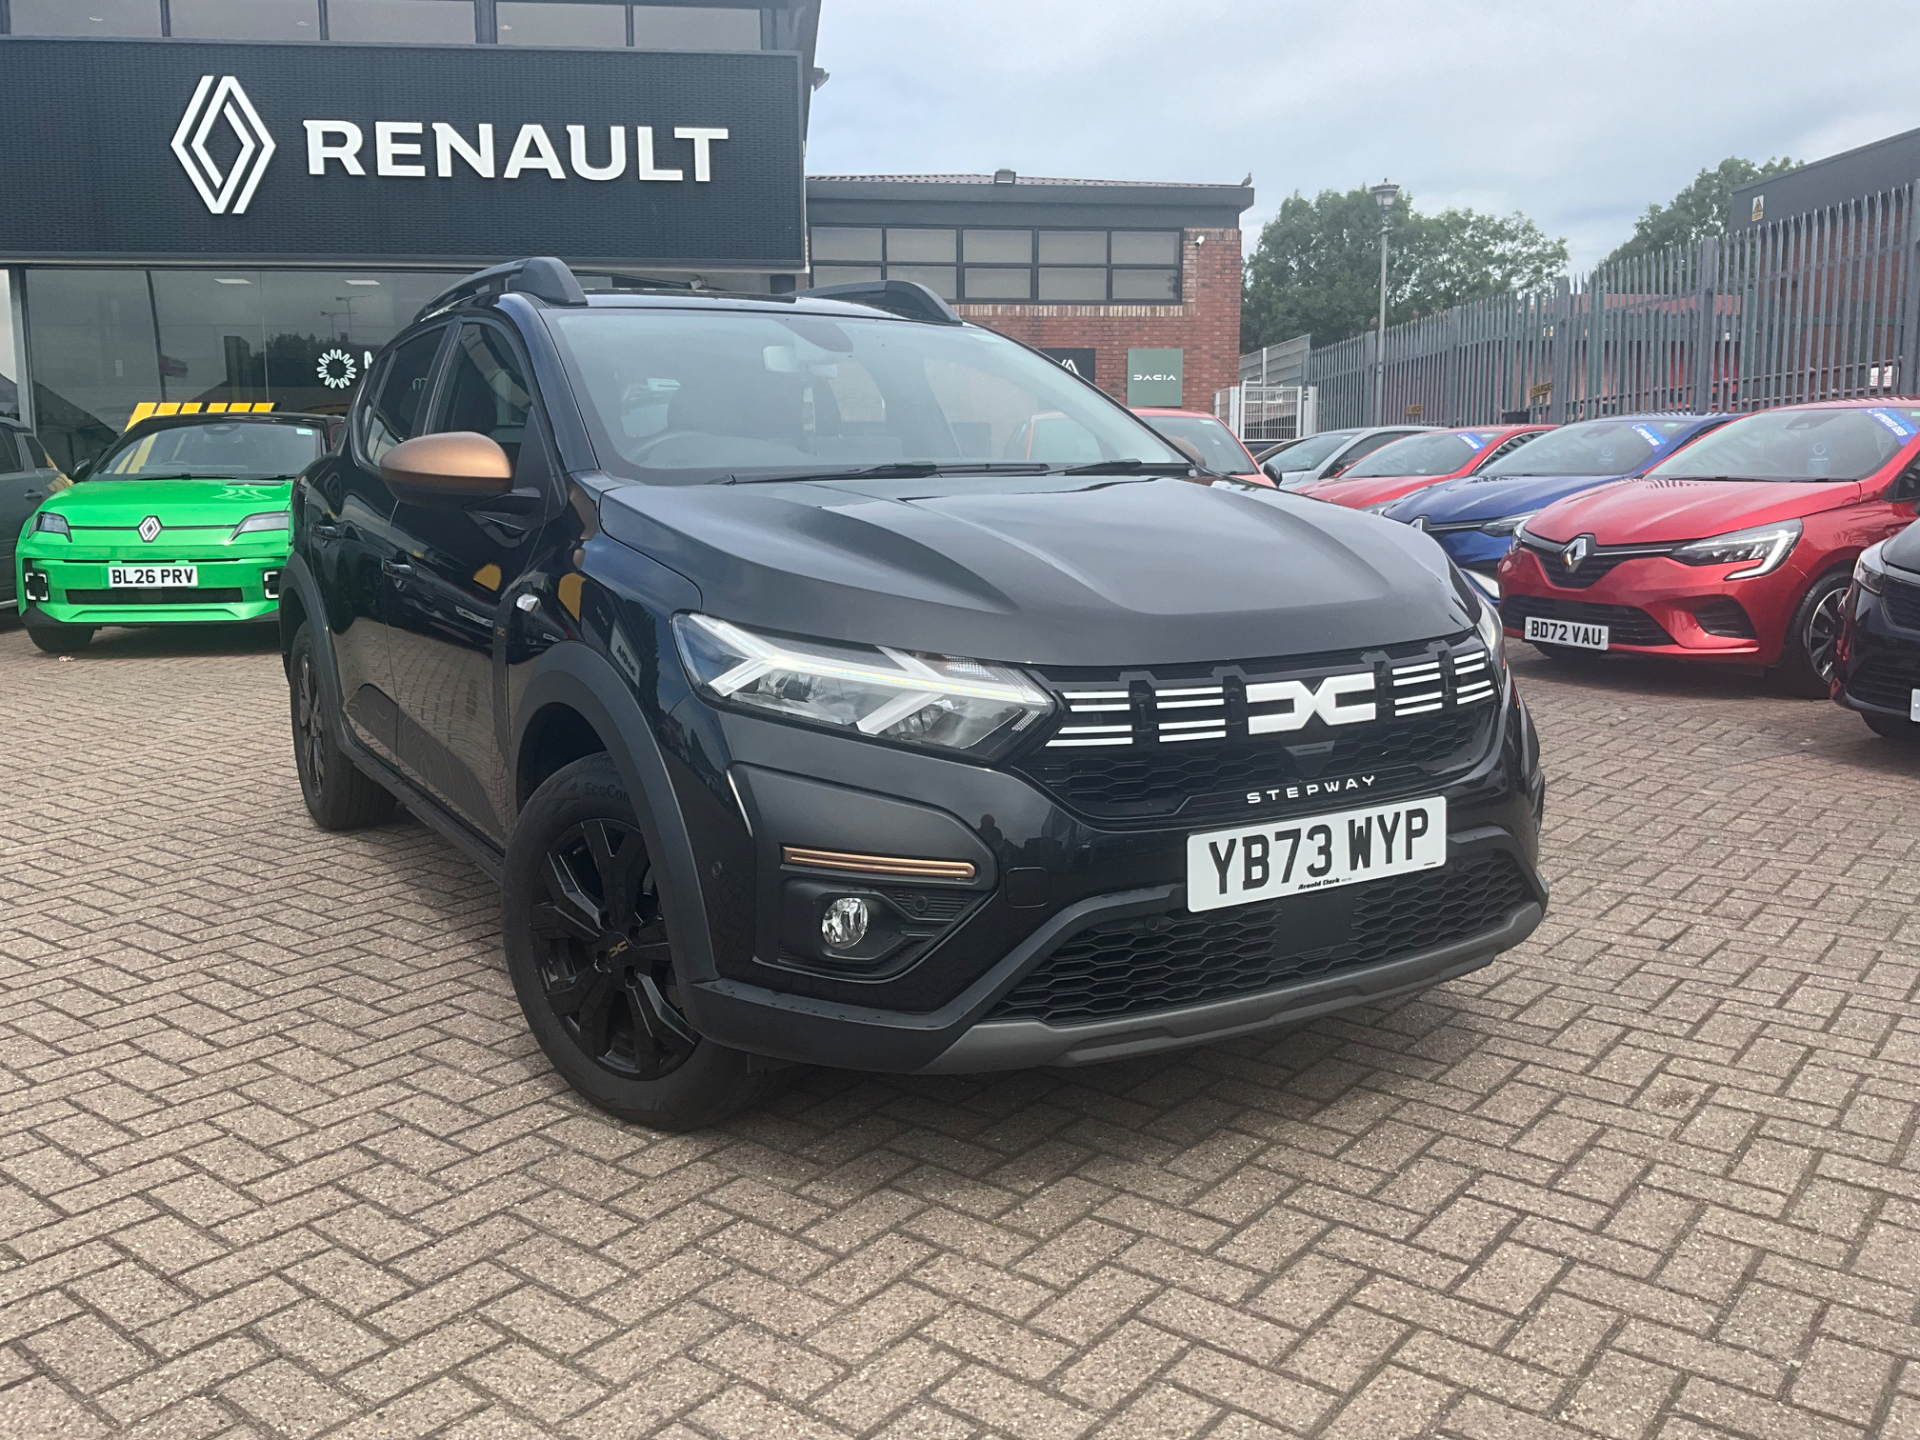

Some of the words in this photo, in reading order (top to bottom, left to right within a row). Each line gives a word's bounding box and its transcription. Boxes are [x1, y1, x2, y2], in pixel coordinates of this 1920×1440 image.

[302, 119, 729, 183] RENAULT
[112, 569, 156, 584] BL26
[160, 568, 193, 584] PRV
[1531, 620, 1568, 641] BD72
[1572, 625, 1602, 646] VAU
[1246, 775, 1376, 804] STEPWAY
[1208, 824, 1332, 895] YB73
[1348, 808, 1429, 871] WYP
[1297, 880, 1322, 890] Arnold
[1322, 877, 1340, 886] Clark
